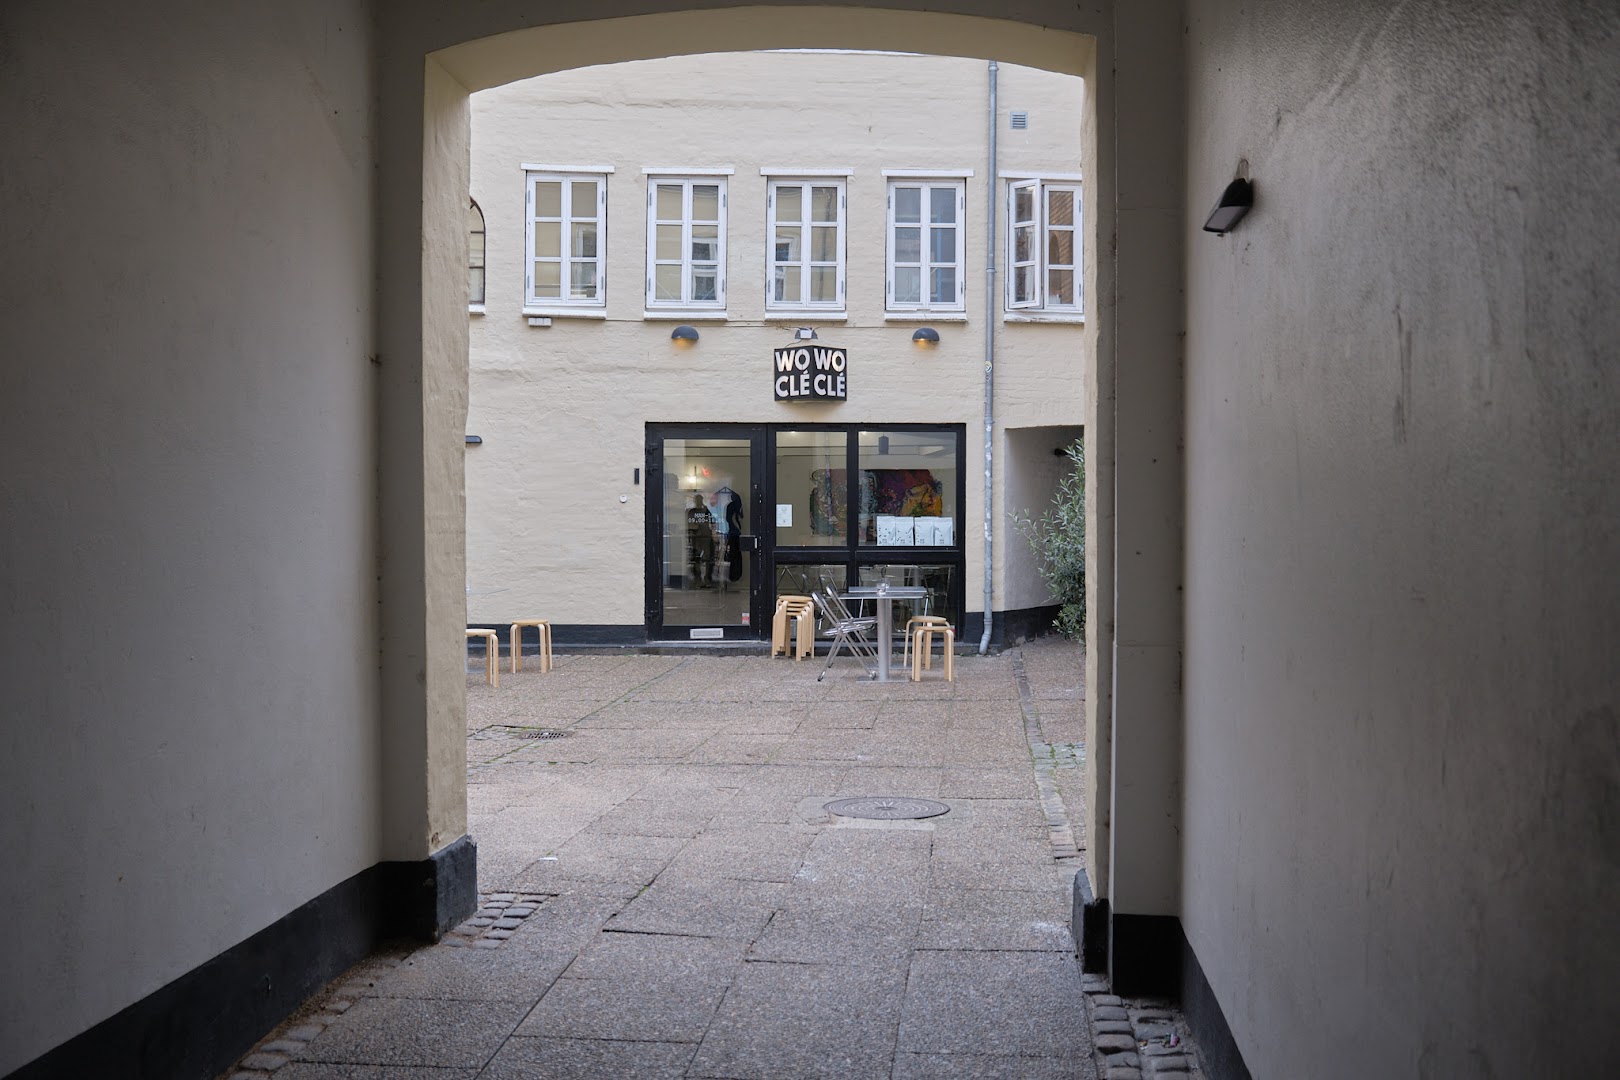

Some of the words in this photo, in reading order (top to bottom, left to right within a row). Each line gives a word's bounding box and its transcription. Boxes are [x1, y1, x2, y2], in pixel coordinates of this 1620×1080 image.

[775, 349, 810, 371] WO
[813, 348, 846, 372] WO
[775, 370, 810, 397] CLÉ
[814, 372, 845, 397] CLÉ
